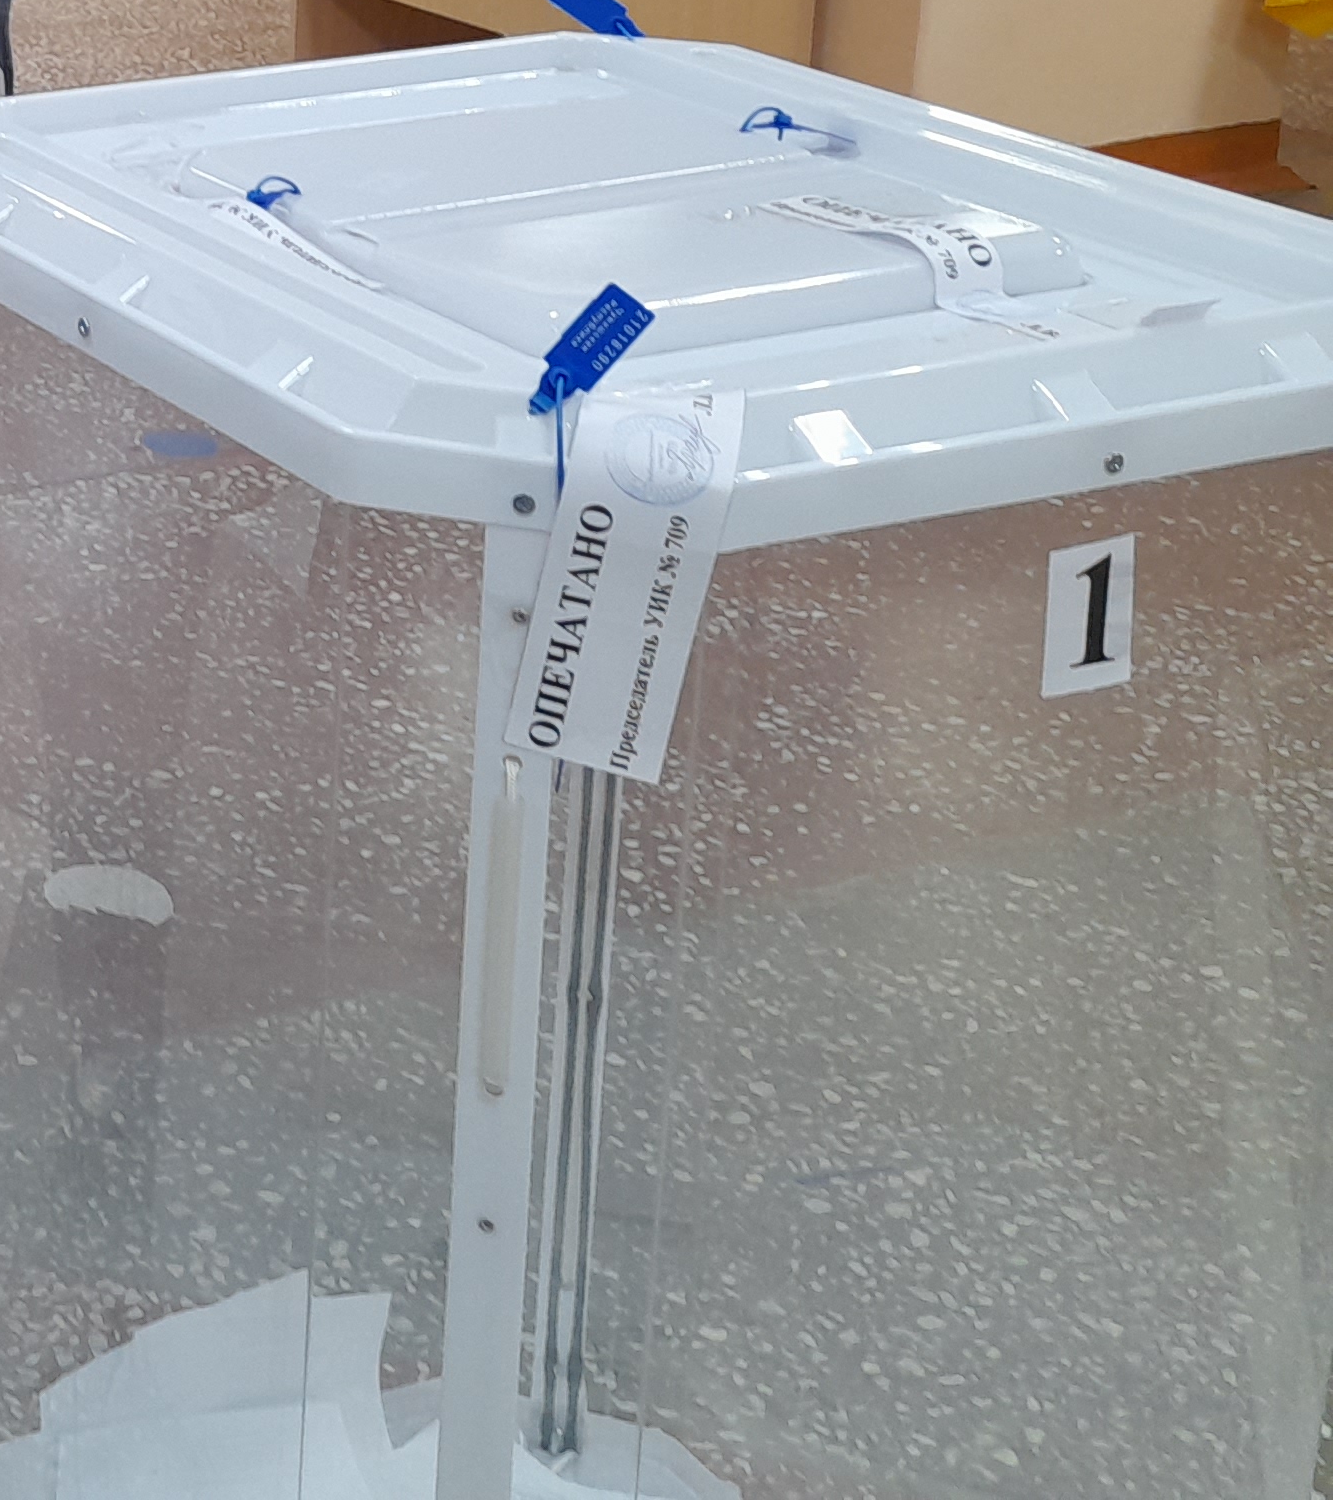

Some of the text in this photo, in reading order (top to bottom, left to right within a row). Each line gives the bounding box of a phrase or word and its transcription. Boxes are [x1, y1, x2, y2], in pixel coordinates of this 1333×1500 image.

[530, 503, 613, 750] ОПЕЧАТАНО
[610, 634, 660, 772] Председатель
[642, 581, 667, 628] УИК
[665, 515, 690, 548] 709
[1069, 552, 1115, 670] 1
